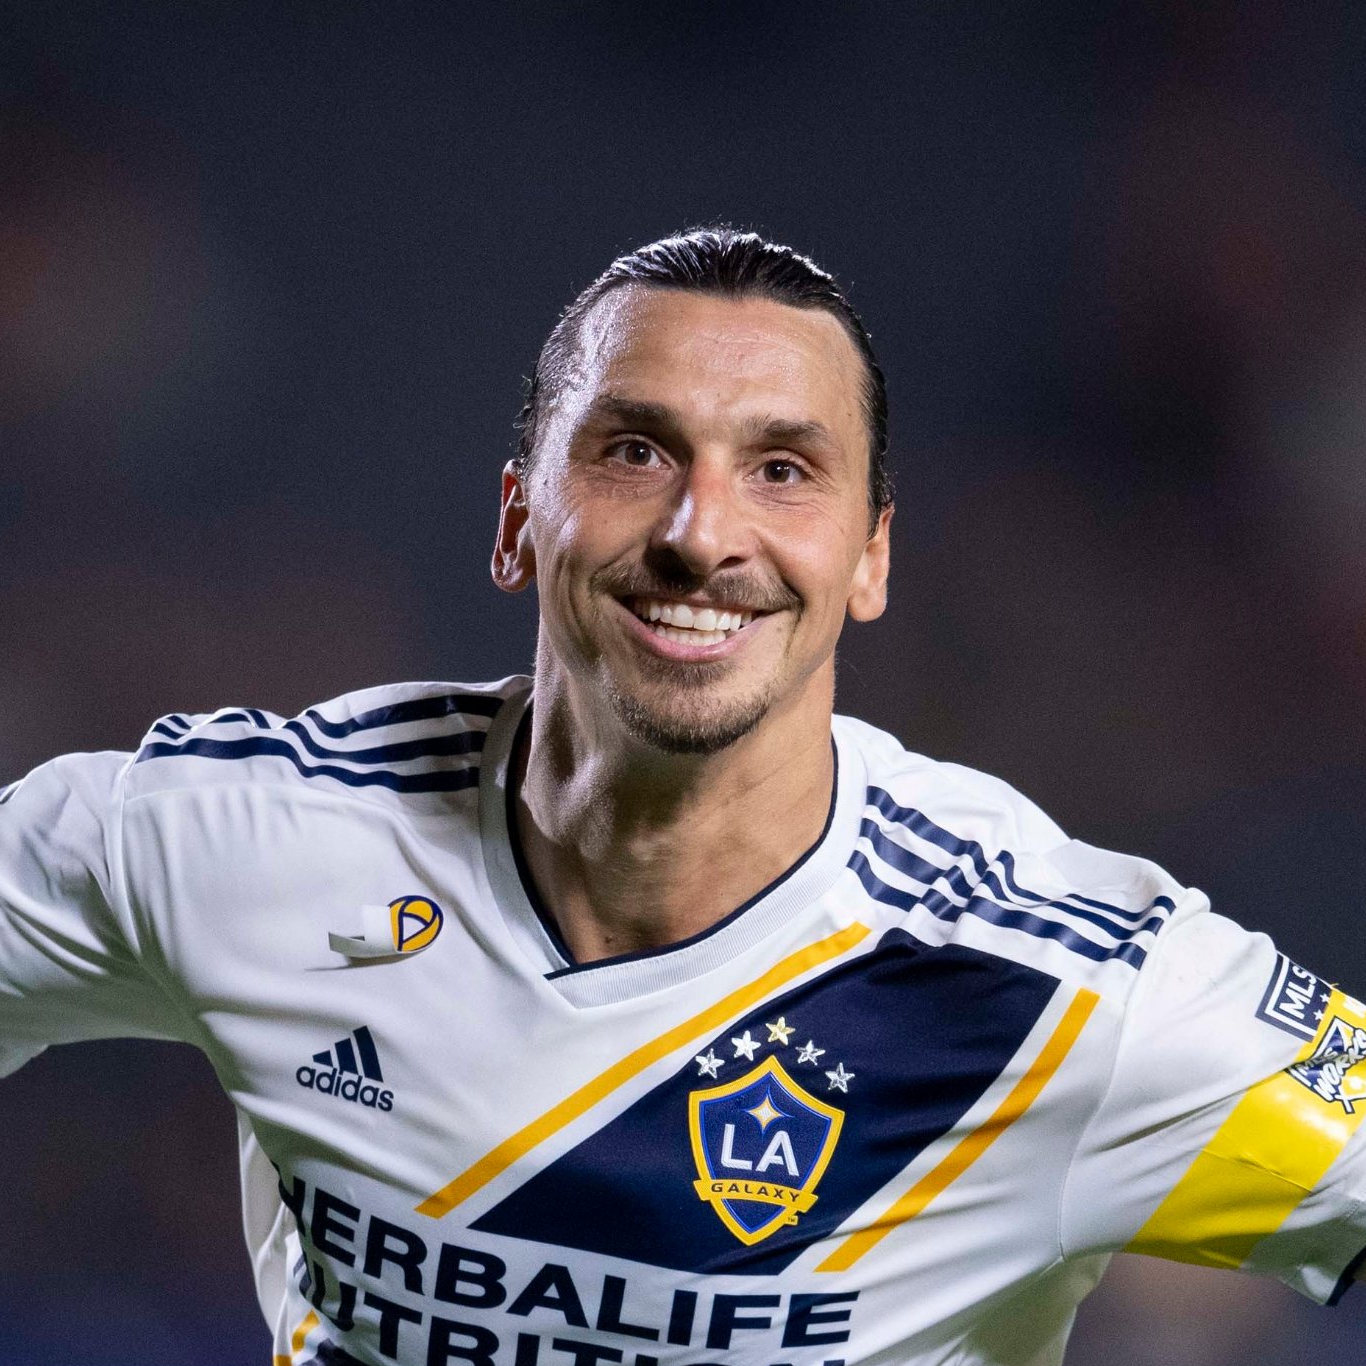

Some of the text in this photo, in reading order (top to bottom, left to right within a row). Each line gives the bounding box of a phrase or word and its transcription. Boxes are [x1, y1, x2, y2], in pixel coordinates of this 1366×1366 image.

[1278, 963, 1318, 1020] MLS
[295, 1066, 395, 1113] adidas
[720, 1123, 800, 1177] LA
[710, 1182, 800, 1203] GALAXY
